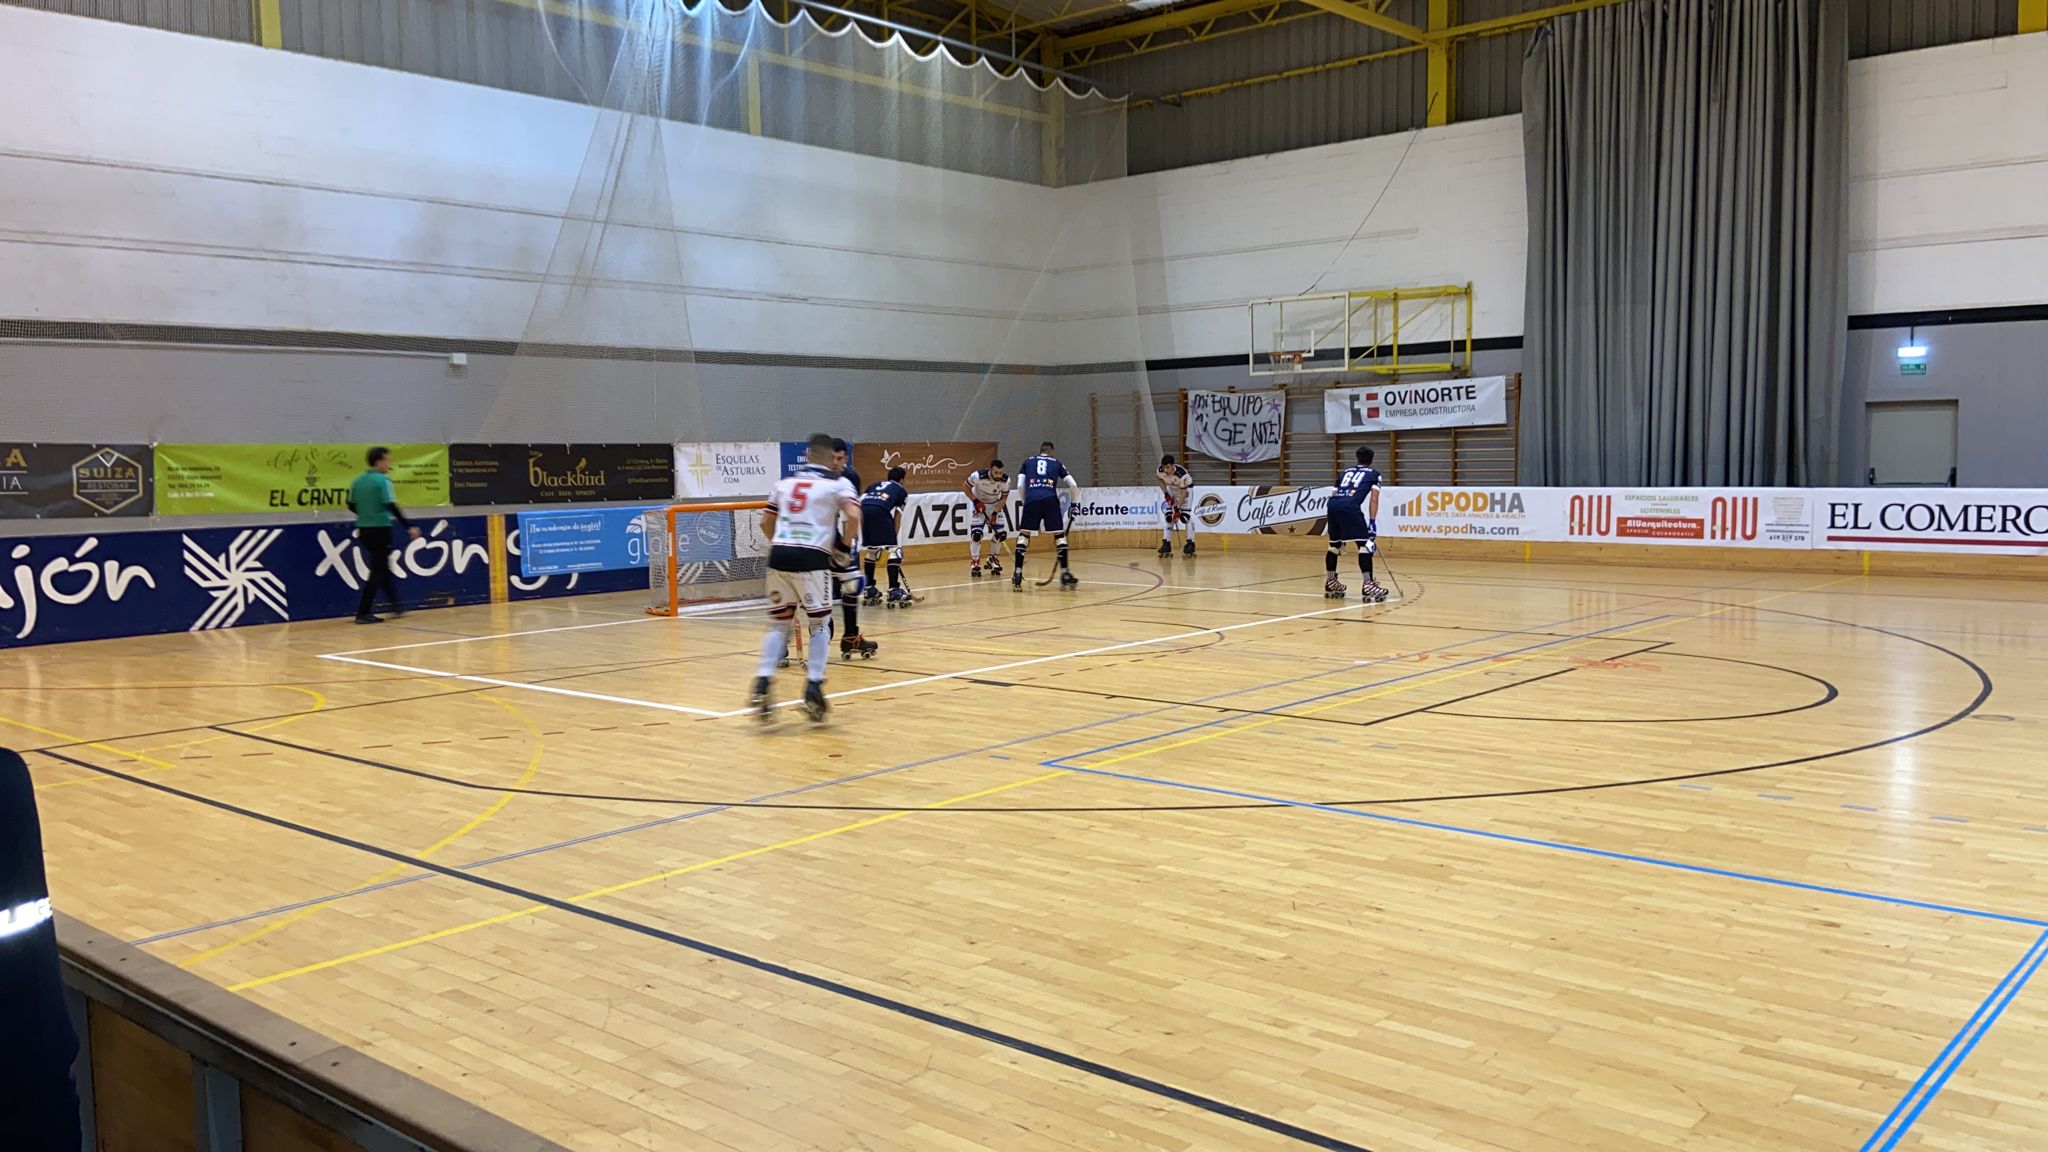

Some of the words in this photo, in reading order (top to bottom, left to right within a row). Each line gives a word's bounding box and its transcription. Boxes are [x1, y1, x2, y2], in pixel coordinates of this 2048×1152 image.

[1384, 385, 1477, 406] OVINORTE
[1210, 394, 1263, 417] EQUIPO
[1385, 408, 1418, 418] EMPRESA
[1419, 404, 1476, 416] CONSTRUCTORA
[716, 454, 760, 465] ESQUELAS
[1037, 460, 1047, 475] 8
[79, 467, 135, 478] SUIZA
[721, 465, 766, 477] ASTURIAS
[1340, 472, 1365, 488] 64
[268, 490, 289, 508] EL
[786, 482, 813, 514] 5
[1237, 494, 1276, 526] Café
[1294, 486, 1331, 514] Rom
[1426, 491, 1525, 514] SPODHA
[1569, 494, 1612, 537] AIU
[1710, 496, 1759, 541] AIU
[1827, 502, 1872, 530] EL
[1879, 503, 2048, 536] COMERC
[1398, 524, 1520, 536] www.spodha.com
